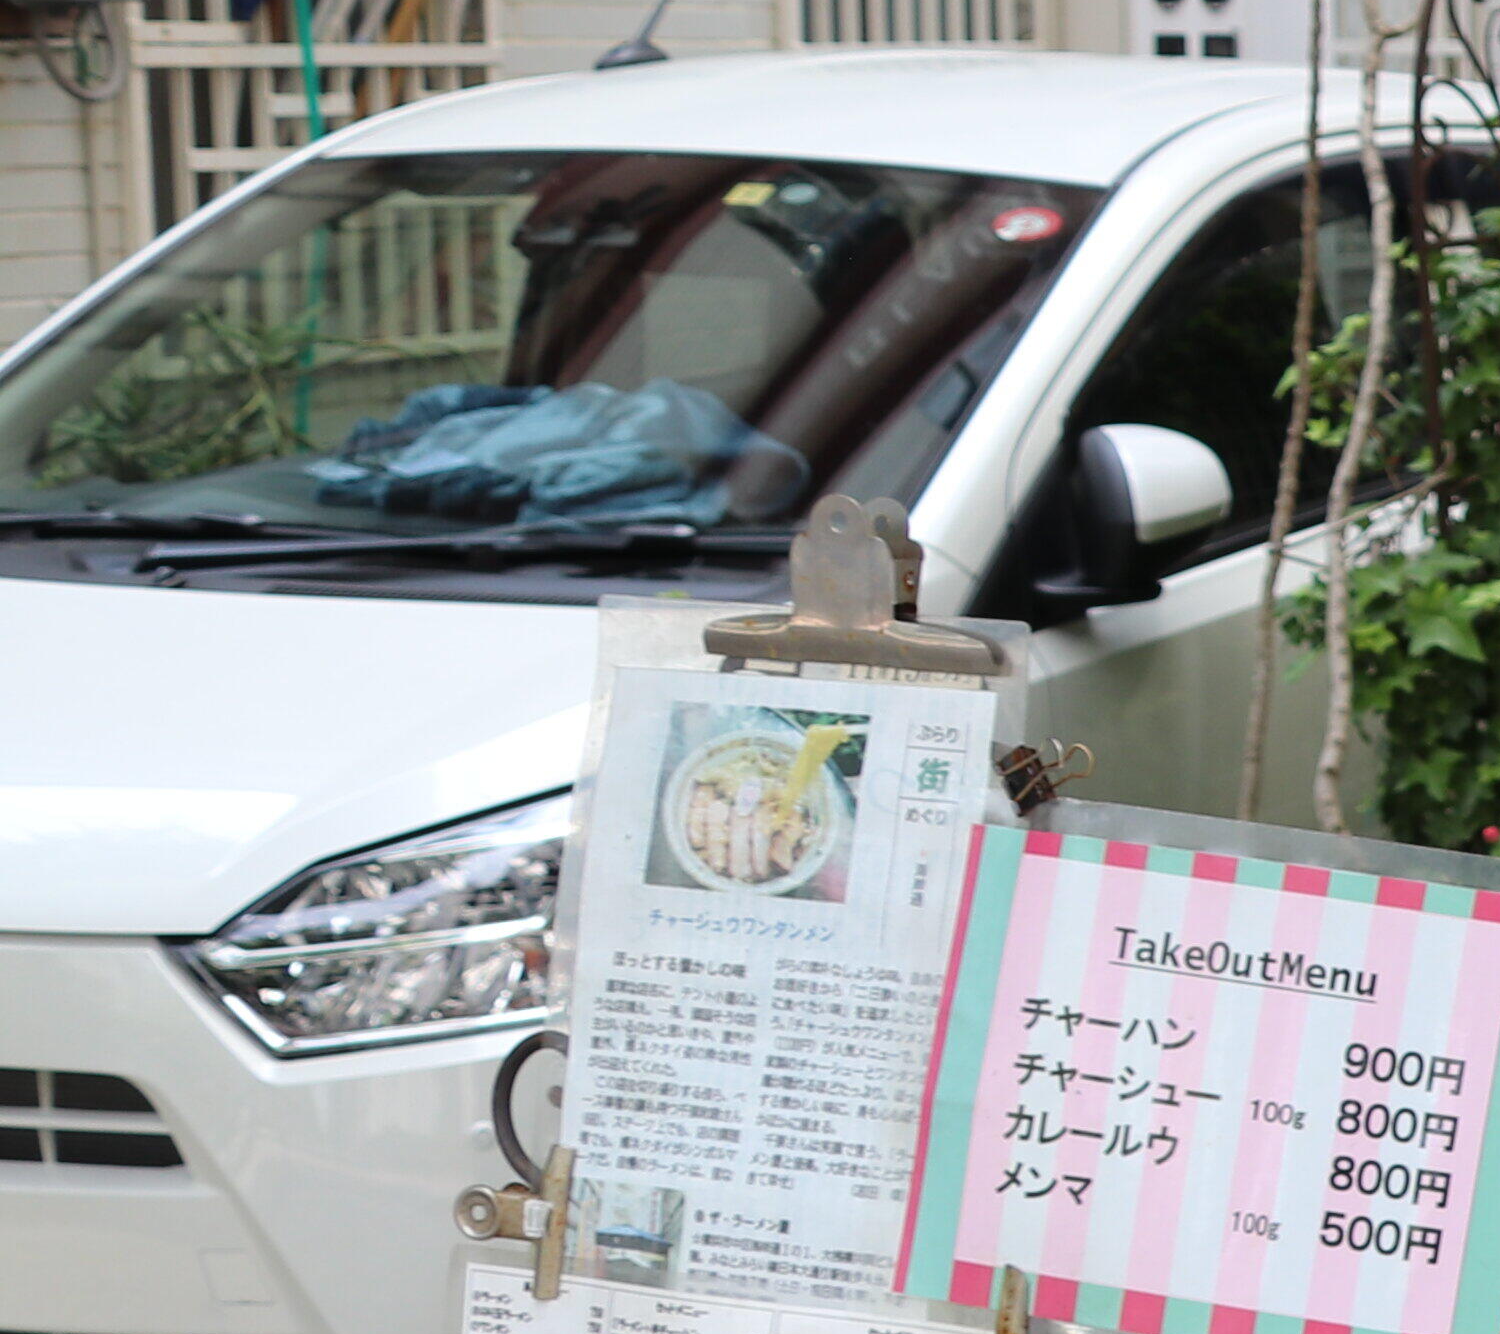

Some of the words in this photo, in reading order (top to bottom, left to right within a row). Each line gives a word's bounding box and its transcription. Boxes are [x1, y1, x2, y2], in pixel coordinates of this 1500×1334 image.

[916, 757, 953, 794] 街
[1114, 926, 1378, 997] TakeOutMenu
[1021, 997, 1196, 1051] チャーハン
[1343, 1042, 1466, 1096] 900円
[1013, 1052, 1222, 1107] チャーシュー
[1250, 1099, 1307, 1130] 100g
[1336, 1099, 1460, 1153] 800円
[1003, 1104, 1179, 1165] カレールウ
[1329, 1155, 1453, 1209] 800円
[996, 1163, 1093, 1205] メンマ
[1231, 1211, 1282, 1241] 100g
[1319, 1211, 1444, 1266] 500円
